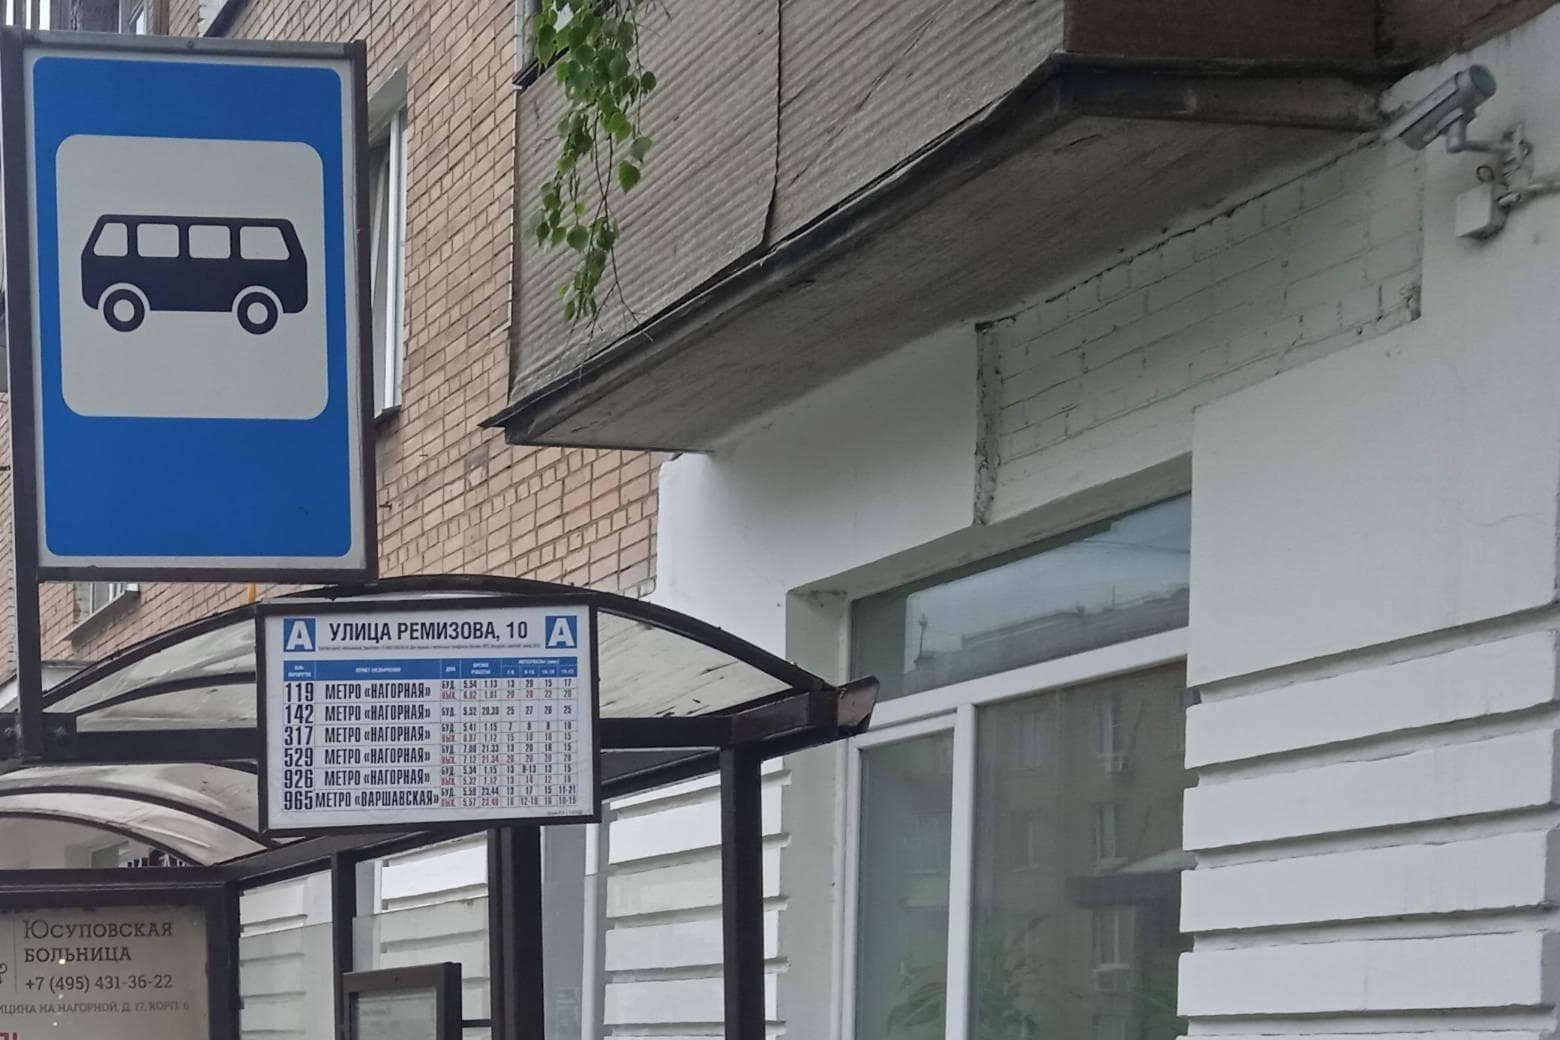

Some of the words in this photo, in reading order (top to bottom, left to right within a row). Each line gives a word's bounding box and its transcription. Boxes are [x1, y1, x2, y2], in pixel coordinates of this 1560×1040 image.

[329, 622, 392, 644] УЛИЦА
[397, 621, 500, 642] РЕМИЗОВА,
[506, 621, 528, 639] 10
[284, 682, 314, 702] 119
[324, 683, 361, 700] МЕТРО
[364, 682, 431, 699] «НАГОРНАЯ»
[284, 704, 314, 724] 142
[324, 705, 361, 721] МЕТРО
[364, 704, 431, 720] «НАГОРНАЯ»
[284, 726, 314, 746] 317
[324, 727, 361, 743] МЕТРО
[364, 725, 431, 742] «НАГОРНАЯ»
[284, 747, 314, 767] 529
[324, 749, 361, 765] МЕТРО
[364, 747, 431, 764] «НАГОРНАЯ»
[284, 769, 314, 789] 926
[324, 770, 361, 786] МЕТРО
[364, 769, 431, 785] «НАГОРНАЯ»
[284, 790, 314, 810] 965
[315, 792, 351, 808] МЕТРО
[24, 946, 132, 963] БОЛЬНИЦА
[25, 976, 44, 991] +7
[49, 975, 90, 994] (495)
[94, 974, 174, 990] 431-36-22
[40, 1003, 55, 1013] НА
